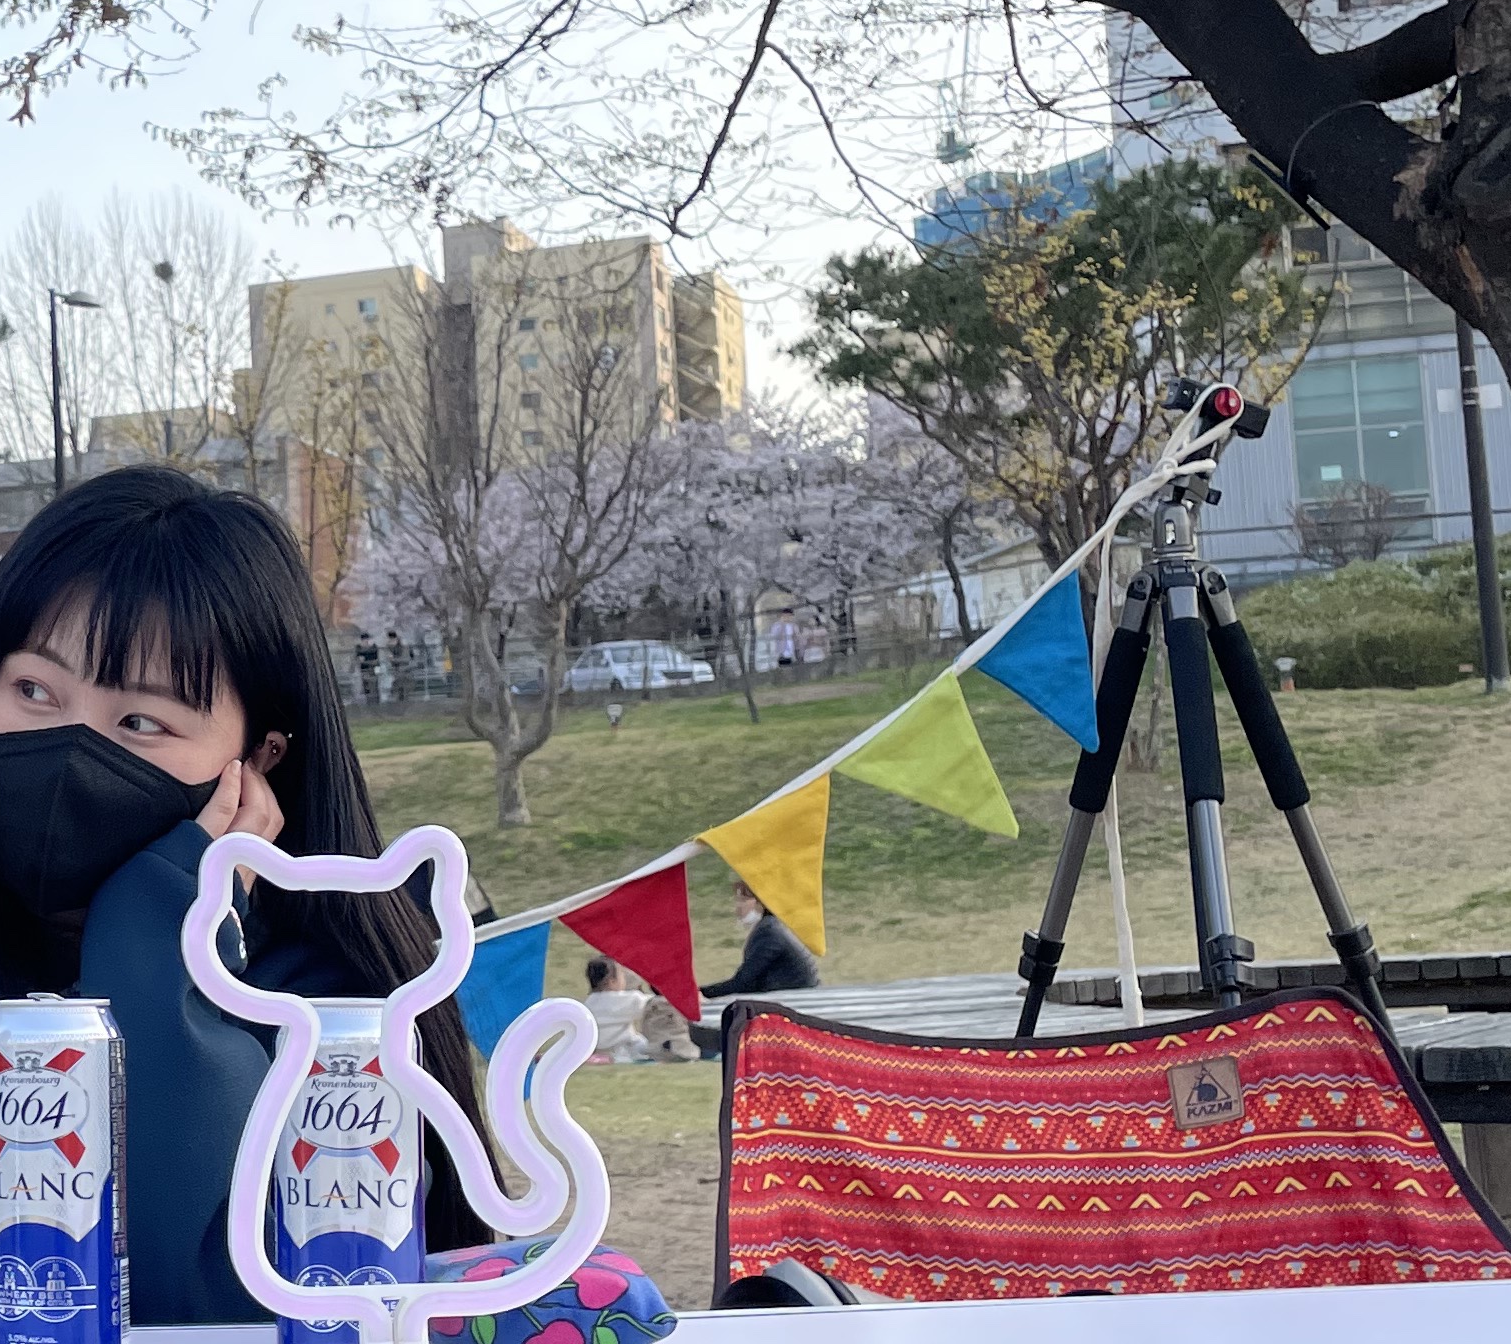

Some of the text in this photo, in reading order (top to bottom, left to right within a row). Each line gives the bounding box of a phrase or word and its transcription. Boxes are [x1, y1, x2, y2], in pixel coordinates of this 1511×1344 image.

[0, 1075, 61, 1087] Kronenbourg
[310, 1078, 378, 1092] Kronenbourg
[300, 1090, 392, 1136] 1664
[286, 1176, 408, 1209] BLANC
